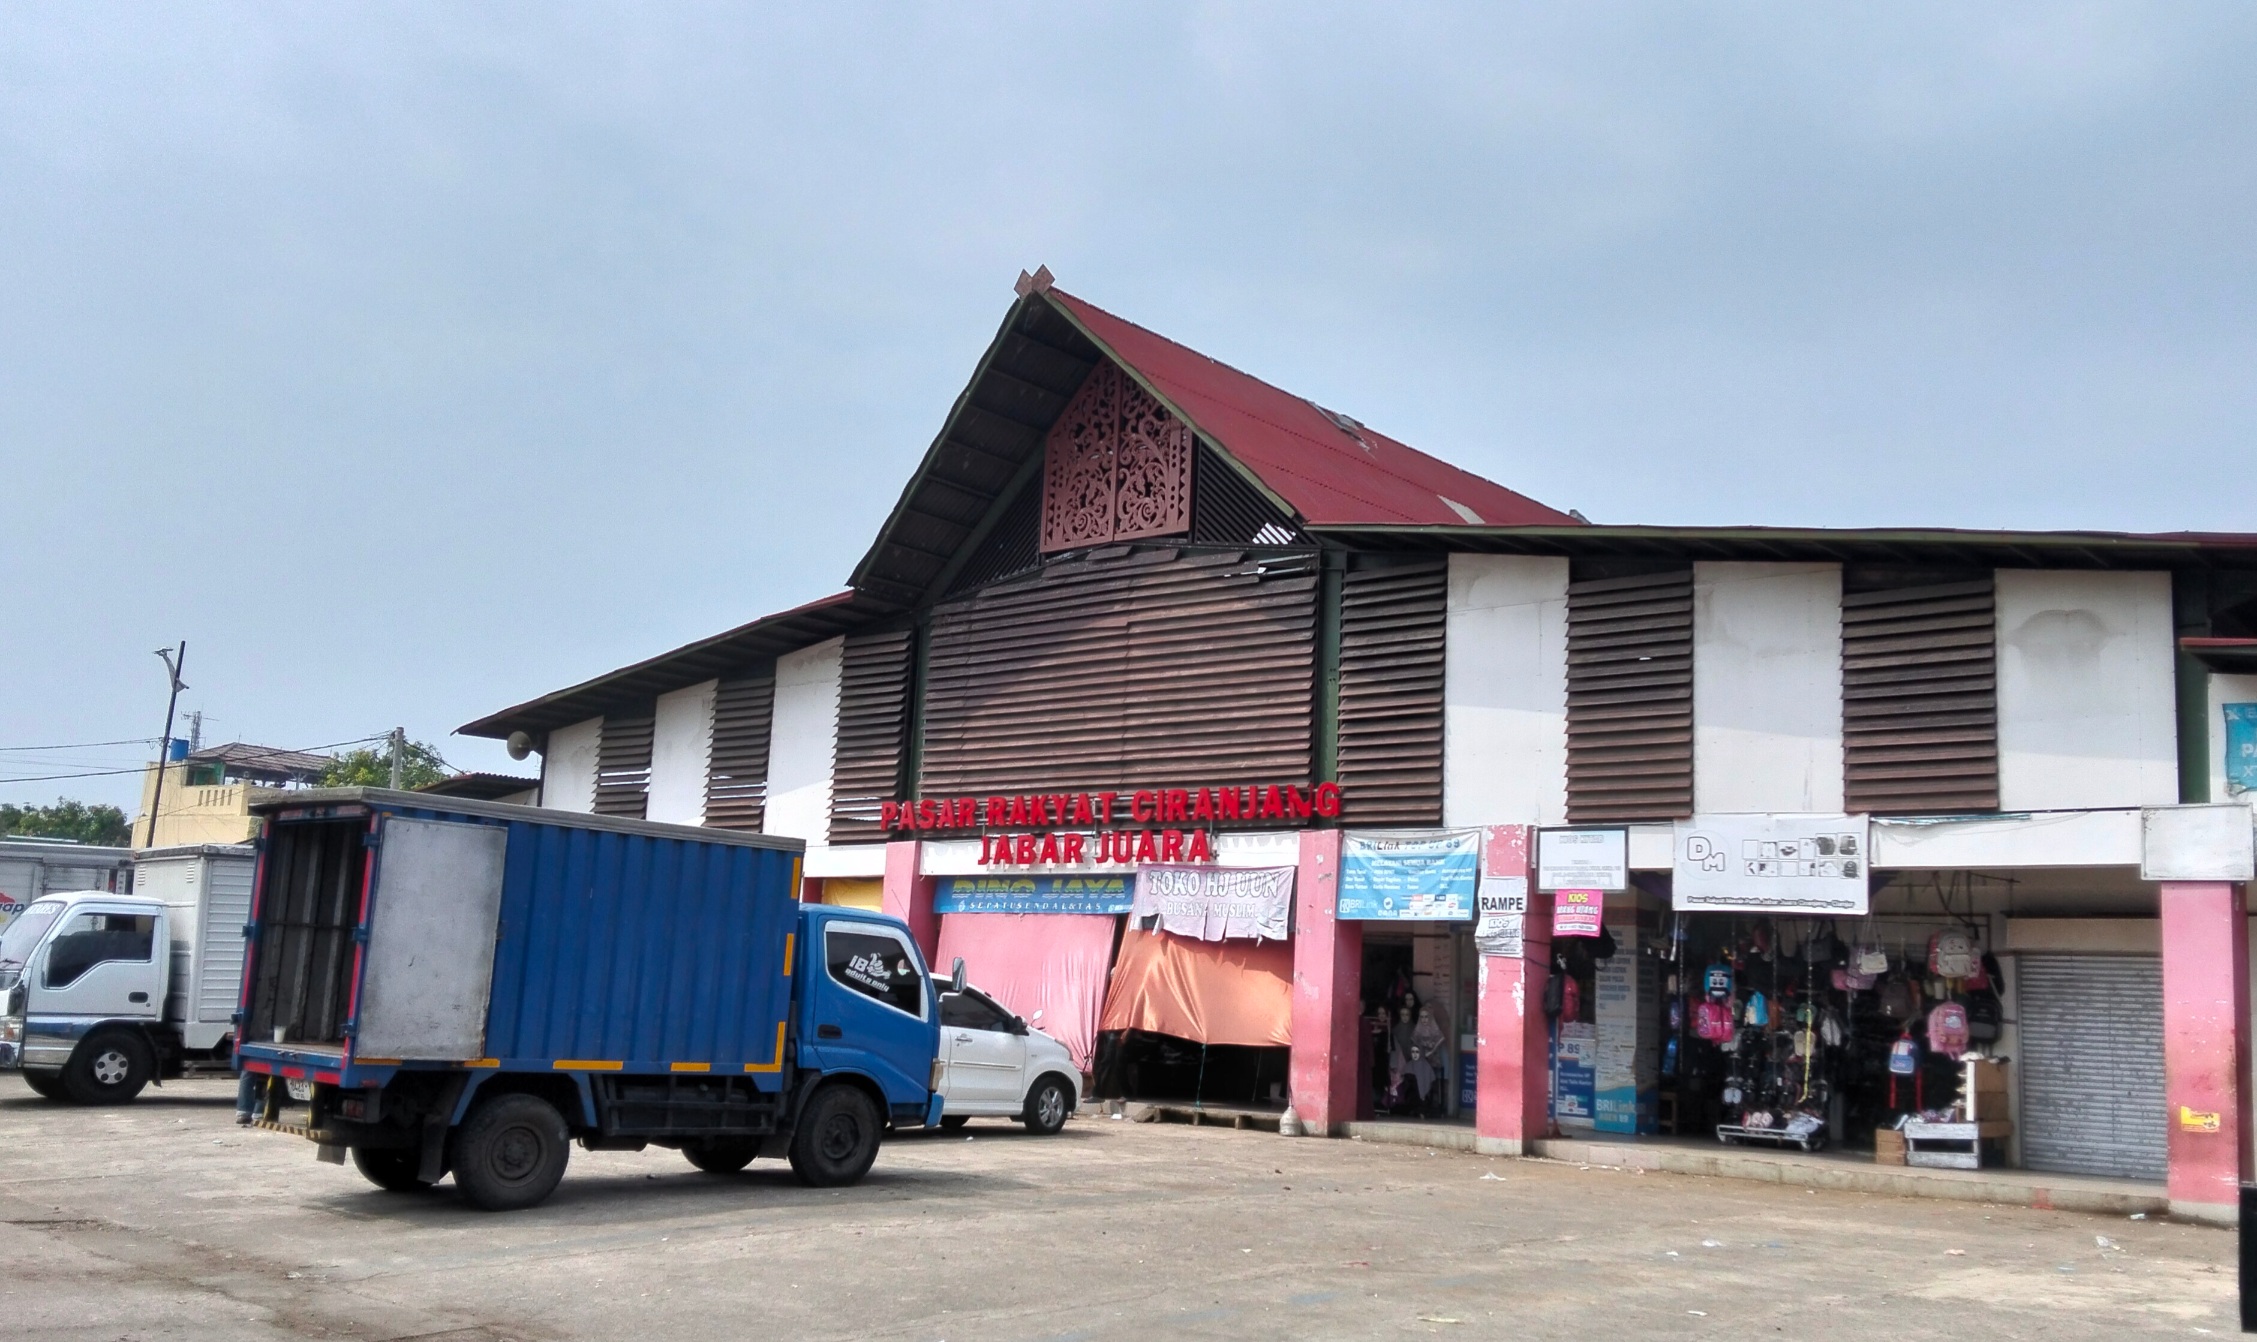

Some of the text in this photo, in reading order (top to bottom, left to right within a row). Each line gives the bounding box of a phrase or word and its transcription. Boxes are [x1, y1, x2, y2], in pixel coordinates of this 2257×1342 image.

[881, 781, 1341, 831] PASAR RAKYAT CIRANJANG
[977, 829, 1211, 865] JABAR JUARA
[952, 879, 1126, 899] DINO JAYA
[1149, 870, 1279, 898] TOKO HJ UUN
[1481, 897, 1523, 910] RAMPE
[1567, 893, 1589, 903] KIOS
[871, 980, 890, 992] only
